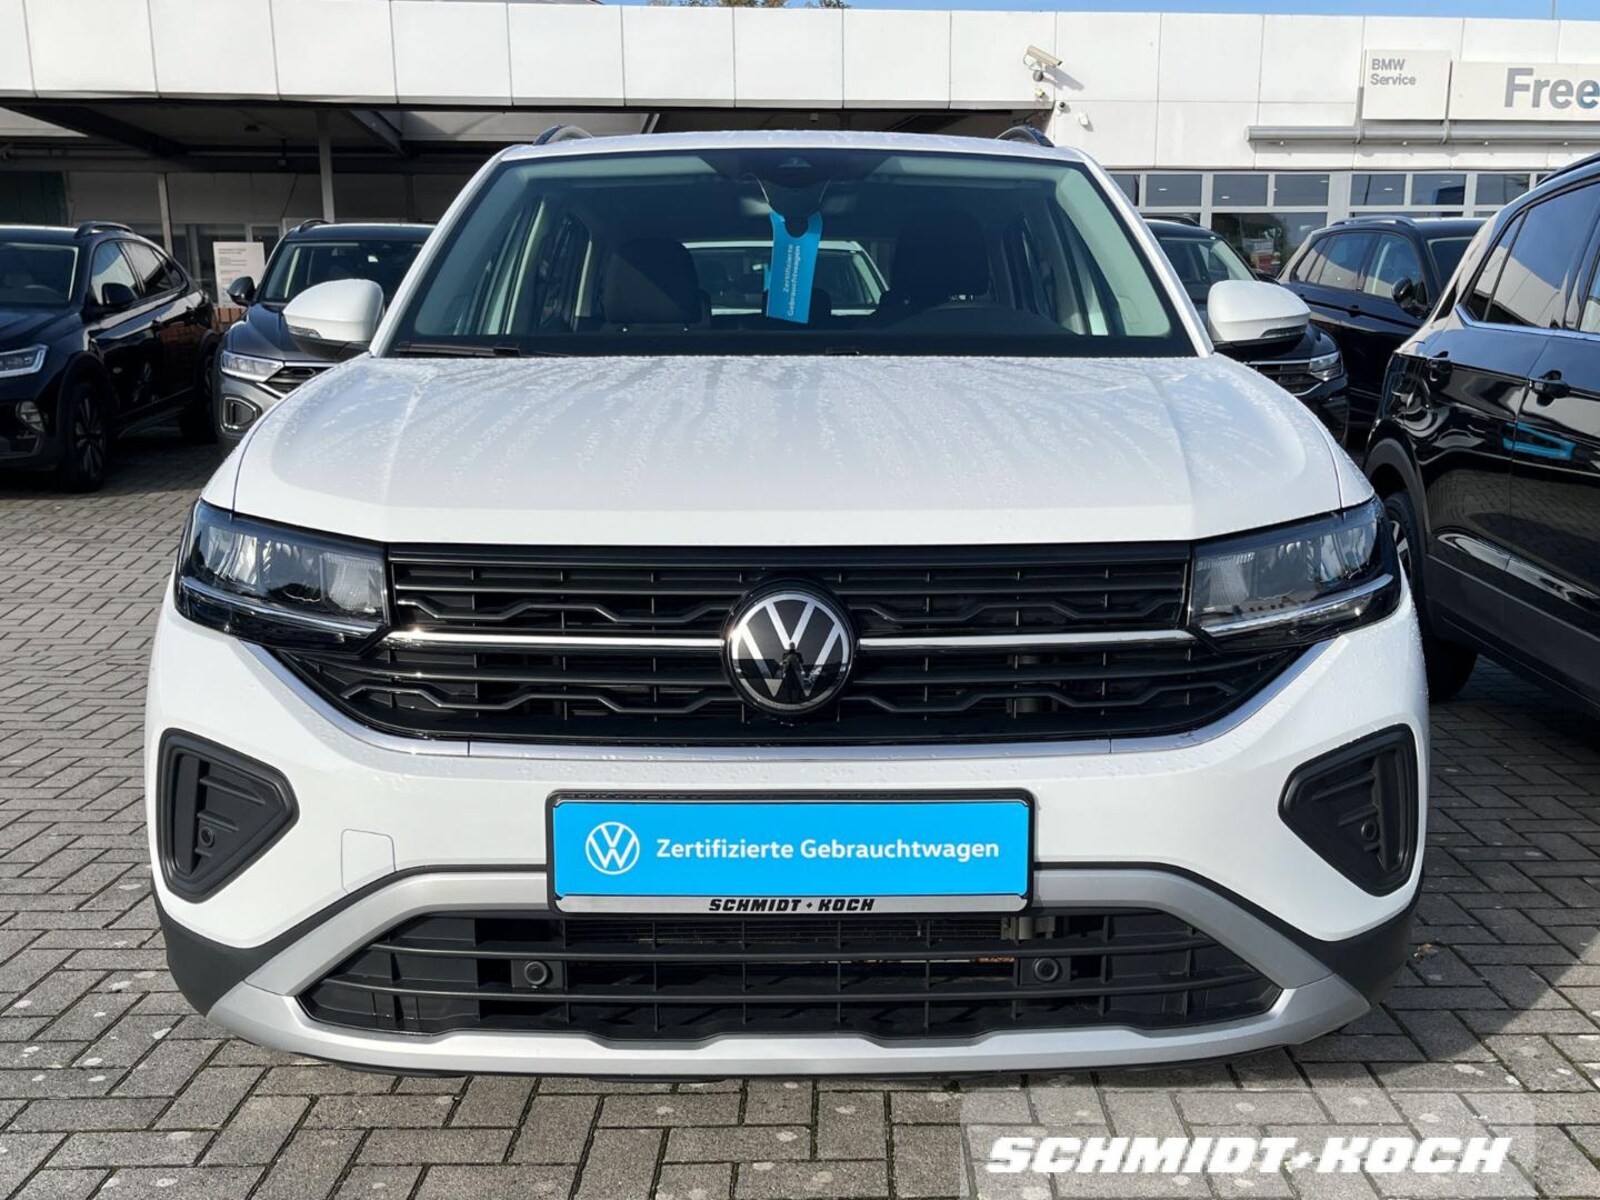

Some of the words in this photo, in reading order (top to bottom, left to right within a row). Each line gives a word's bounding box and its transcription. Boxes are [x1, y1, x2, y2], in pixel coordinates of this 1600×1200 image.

[1371, 58, 1406, 70] BMW
[1370, 73, 1417, 86] Service
[1504, 67, 1600, 109] Free
[656, 838, 794, 859] Zertifizierte
[800, 838, 1000, 863] Gebrauchtwagen
[708, 898, 802, 912] SCHMIDT
[817, 898, 875, 912] KOCH
